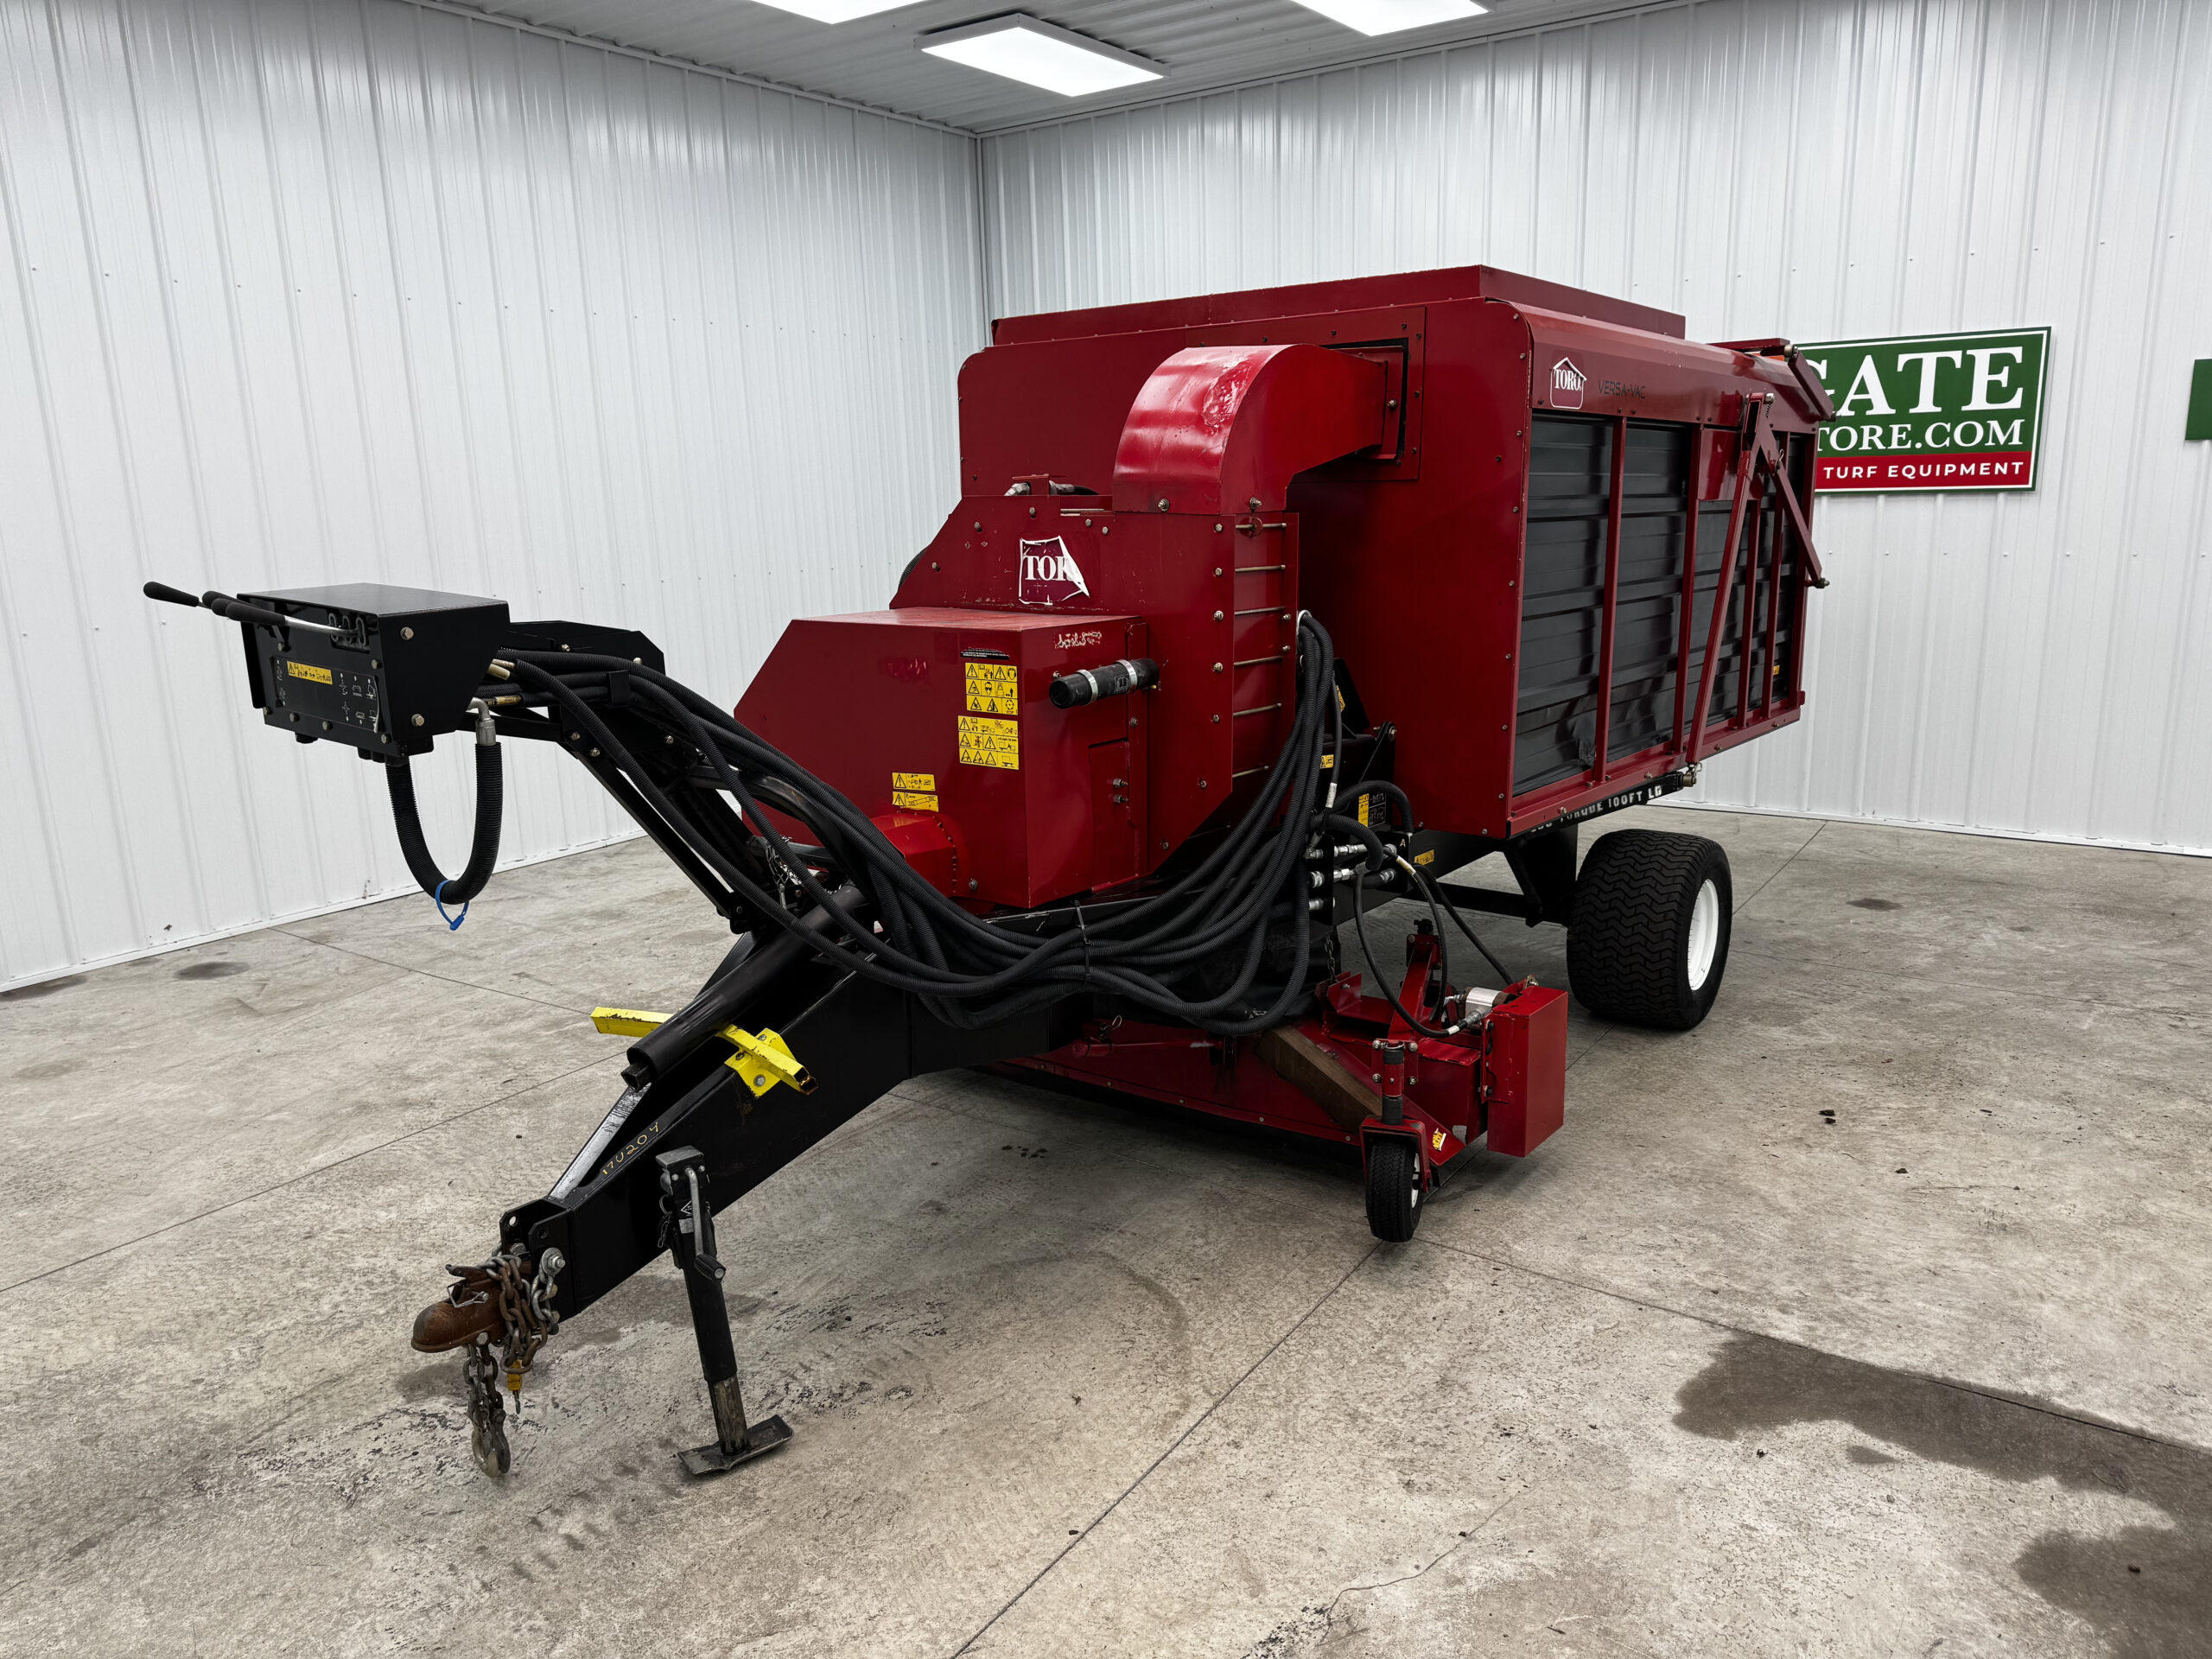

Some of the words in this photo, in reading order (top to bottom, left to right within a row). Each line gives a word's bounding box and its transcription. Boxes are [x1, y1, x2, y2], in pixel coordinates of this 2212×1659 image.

[1554, 369, 1581, 391] TORO
[1823, 466, 1878, 480] TURF
[1887, 461, 2024, 480] EQUIPMENT
[1023, 556, 1072, 582] TOR
[1560, 801, 1604, 823] RQUE
